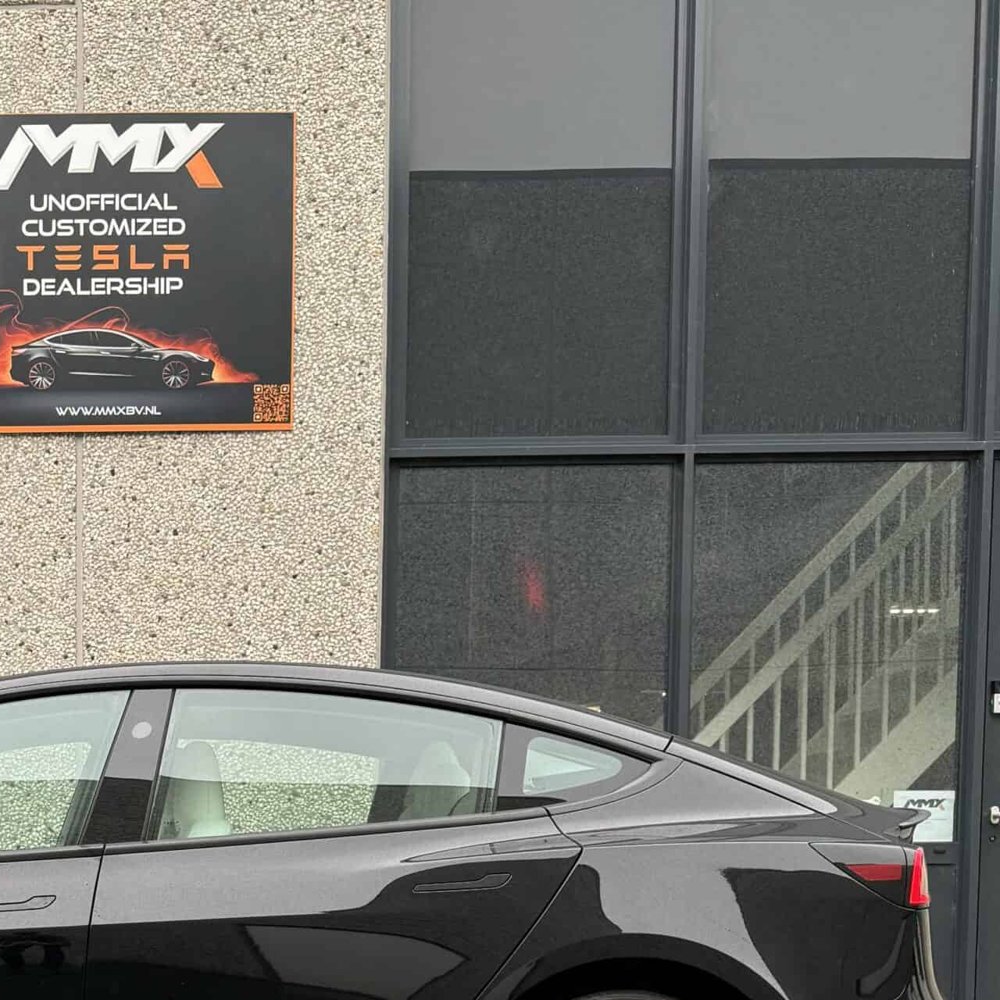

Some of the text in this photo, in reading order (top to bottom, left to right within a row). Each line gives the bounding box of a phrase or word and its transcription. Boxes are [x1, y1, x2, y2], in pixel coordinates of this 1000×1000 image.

[29, 193, 178, 212] UNOFFICIAL
[21, 218, 186, 237] CUSTOMIZED
[16, 244, 190, 271] TESLA
[23, 276, 183, 297] DEALERSHIP
[55, 405, 162, 417] WWW.MMXBV.NL
[904, 798, 946, 811] MMX
